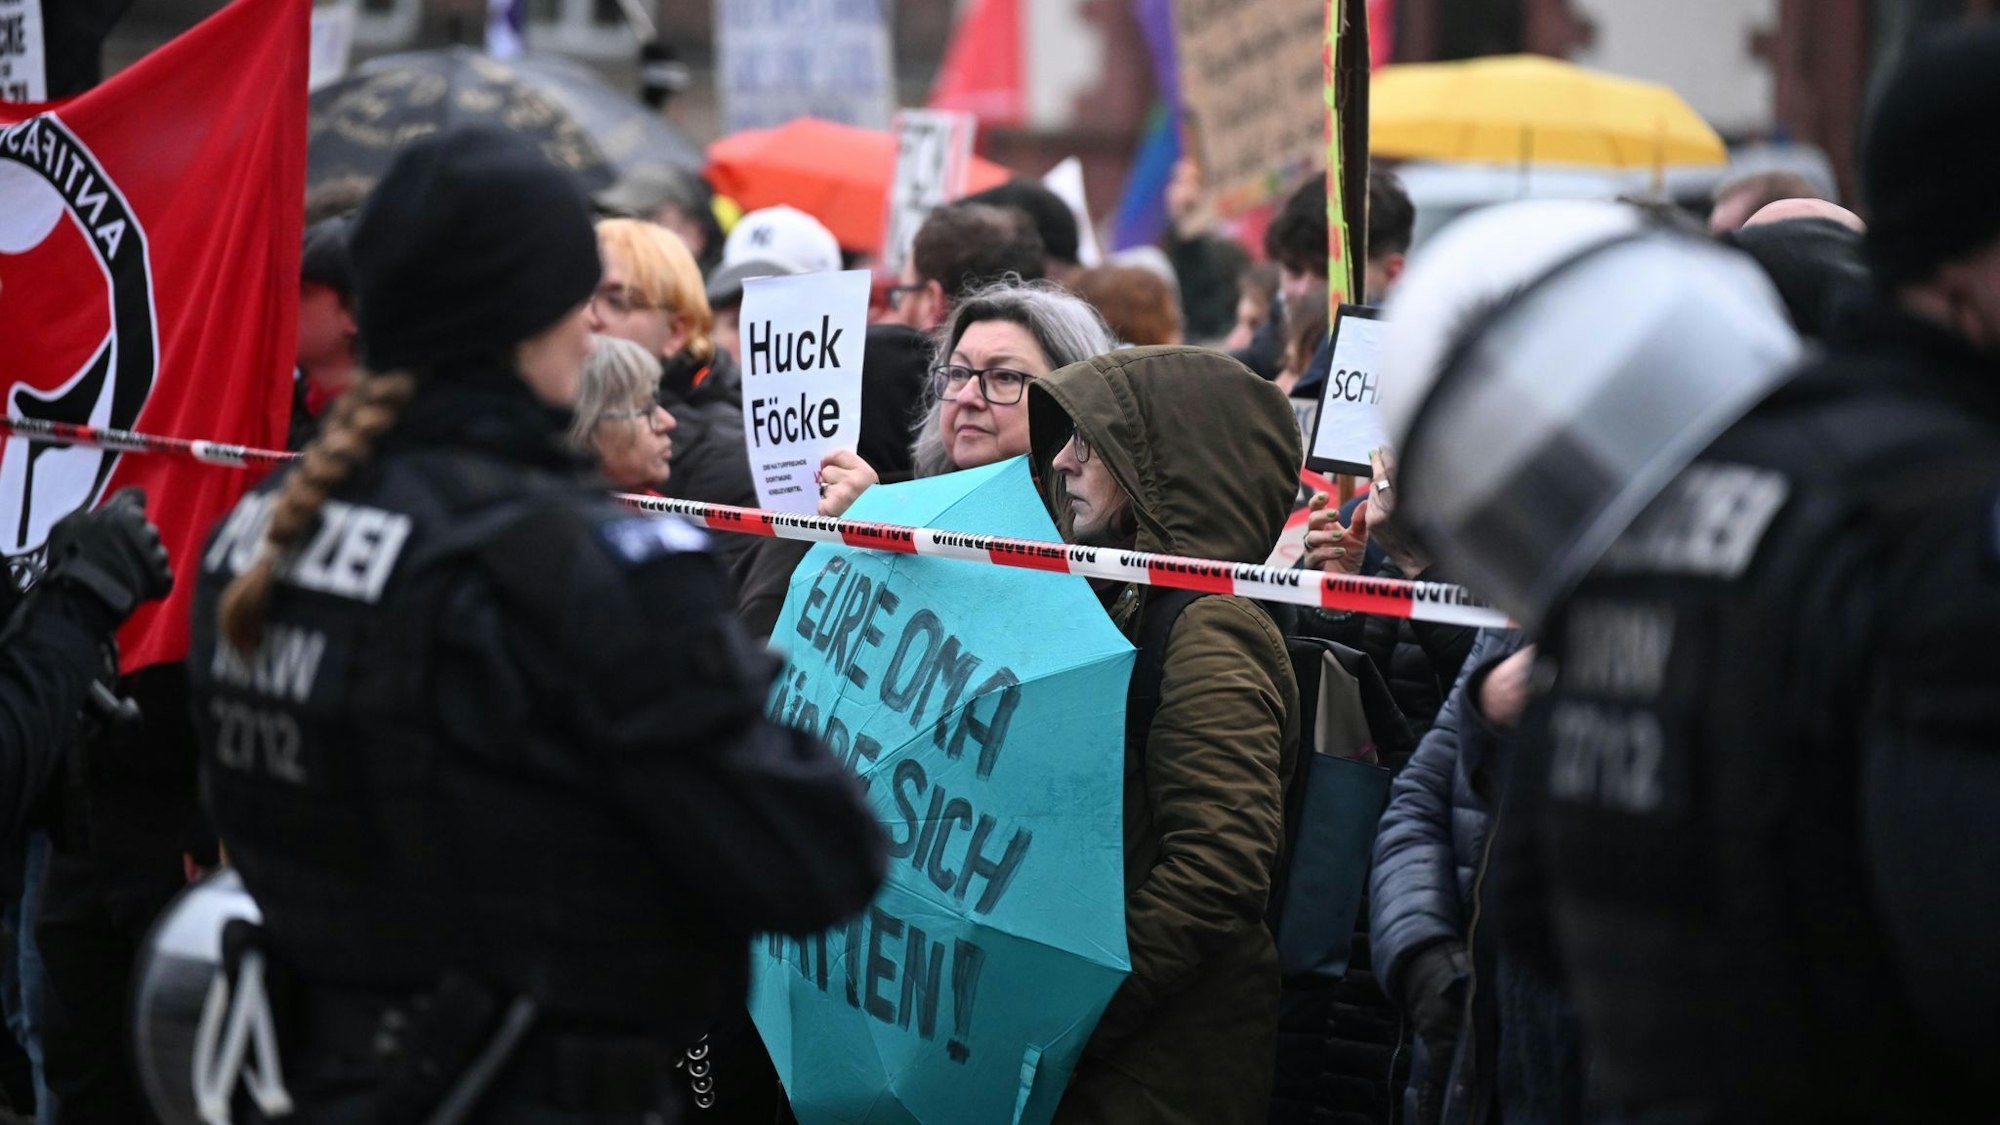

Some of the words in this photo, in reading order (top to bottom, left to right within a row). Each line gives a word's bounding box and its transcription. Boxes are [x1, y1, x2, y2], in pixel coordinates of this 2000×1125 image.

[750, 315, 843, 375] Huck
[1332, 369, 1382, 406] SCH
[751, 392, 840, 447] Föcke
[796, 555, 900, 690] EURE
[880, 609, 1021, 781] OMA
[885, 759, 1033, 915] SICH
